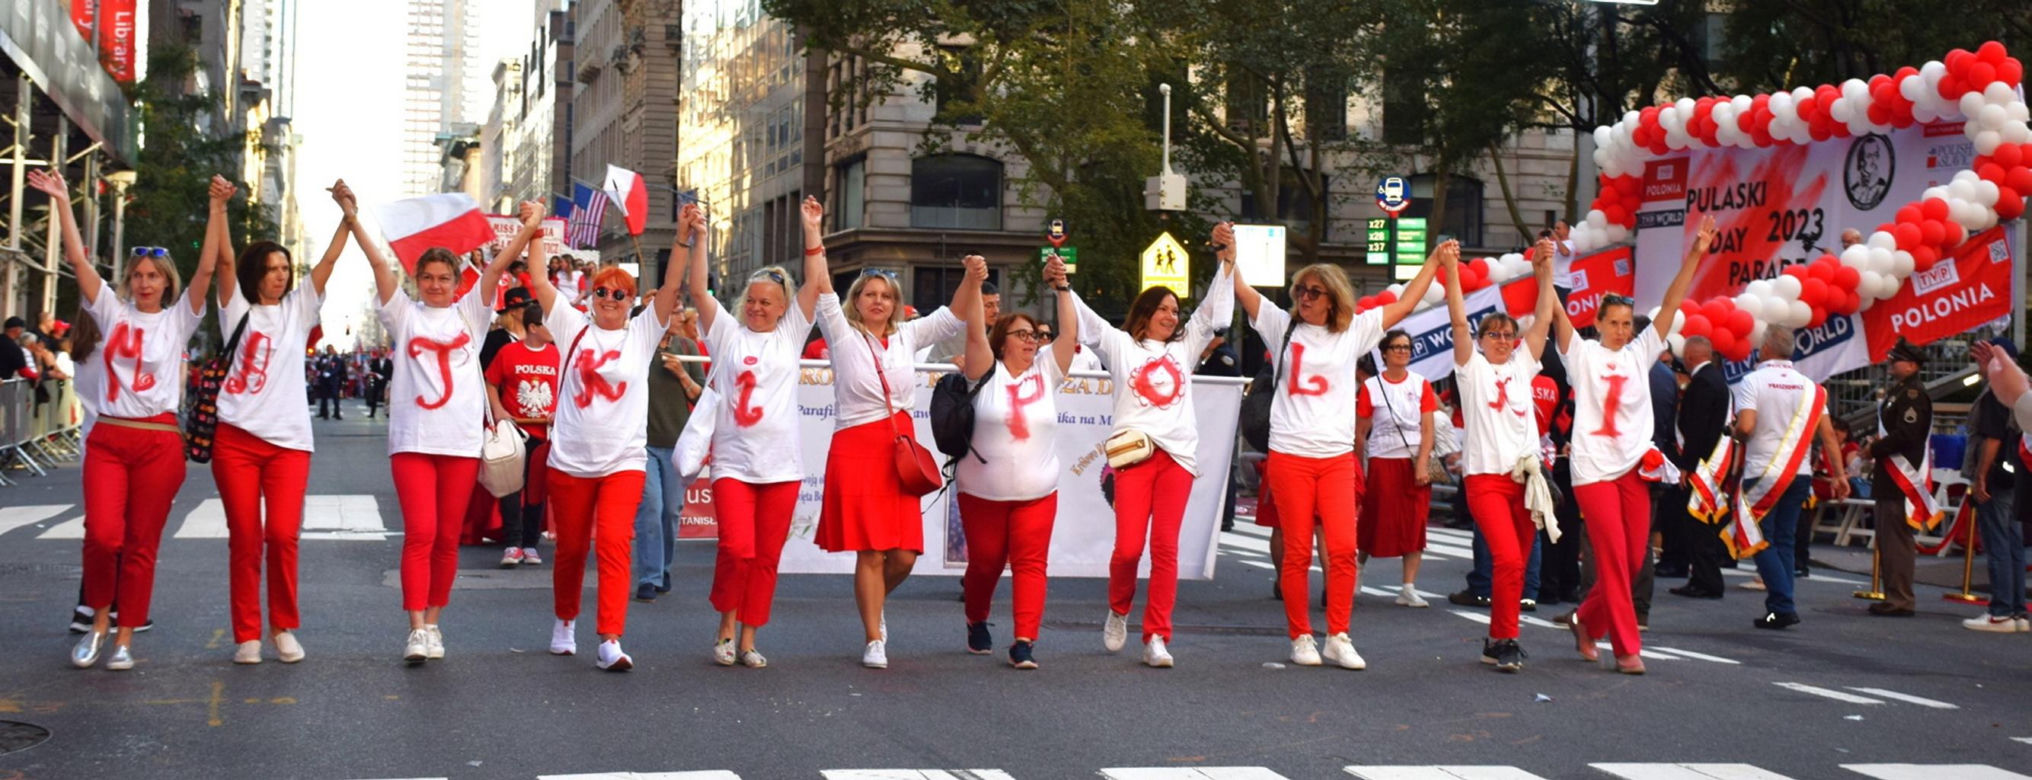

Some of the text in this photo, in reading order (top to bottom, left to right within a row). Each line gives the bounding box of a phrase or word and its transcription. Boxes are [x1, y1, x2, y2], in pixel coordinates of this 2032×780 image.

[109, 12, 131, 76] Library
[1646, 184, 1682, 198] POLONIA
[1686, 181, 1767, 213] PULASKI
[1656, 212, 1683, 226] WORLD
[1766, 207, 1825, 243] 2023
[1708, 226, 1749, 254] DAY
[1728, 257, 1807, 287] PARA
[1920, 266, 1949, 286] TVP
[1891, 281, 1995, 334] POLONIA
[1795, 316, 1848, 356] ORLD
[515, 364, 556, 376] POLSKA
[573, 348, 627, 409] K
[1288, 341, 1329, 396] L
[798, 404, 834, 421] Parafi
[1079, 415, 1096, 425] na
